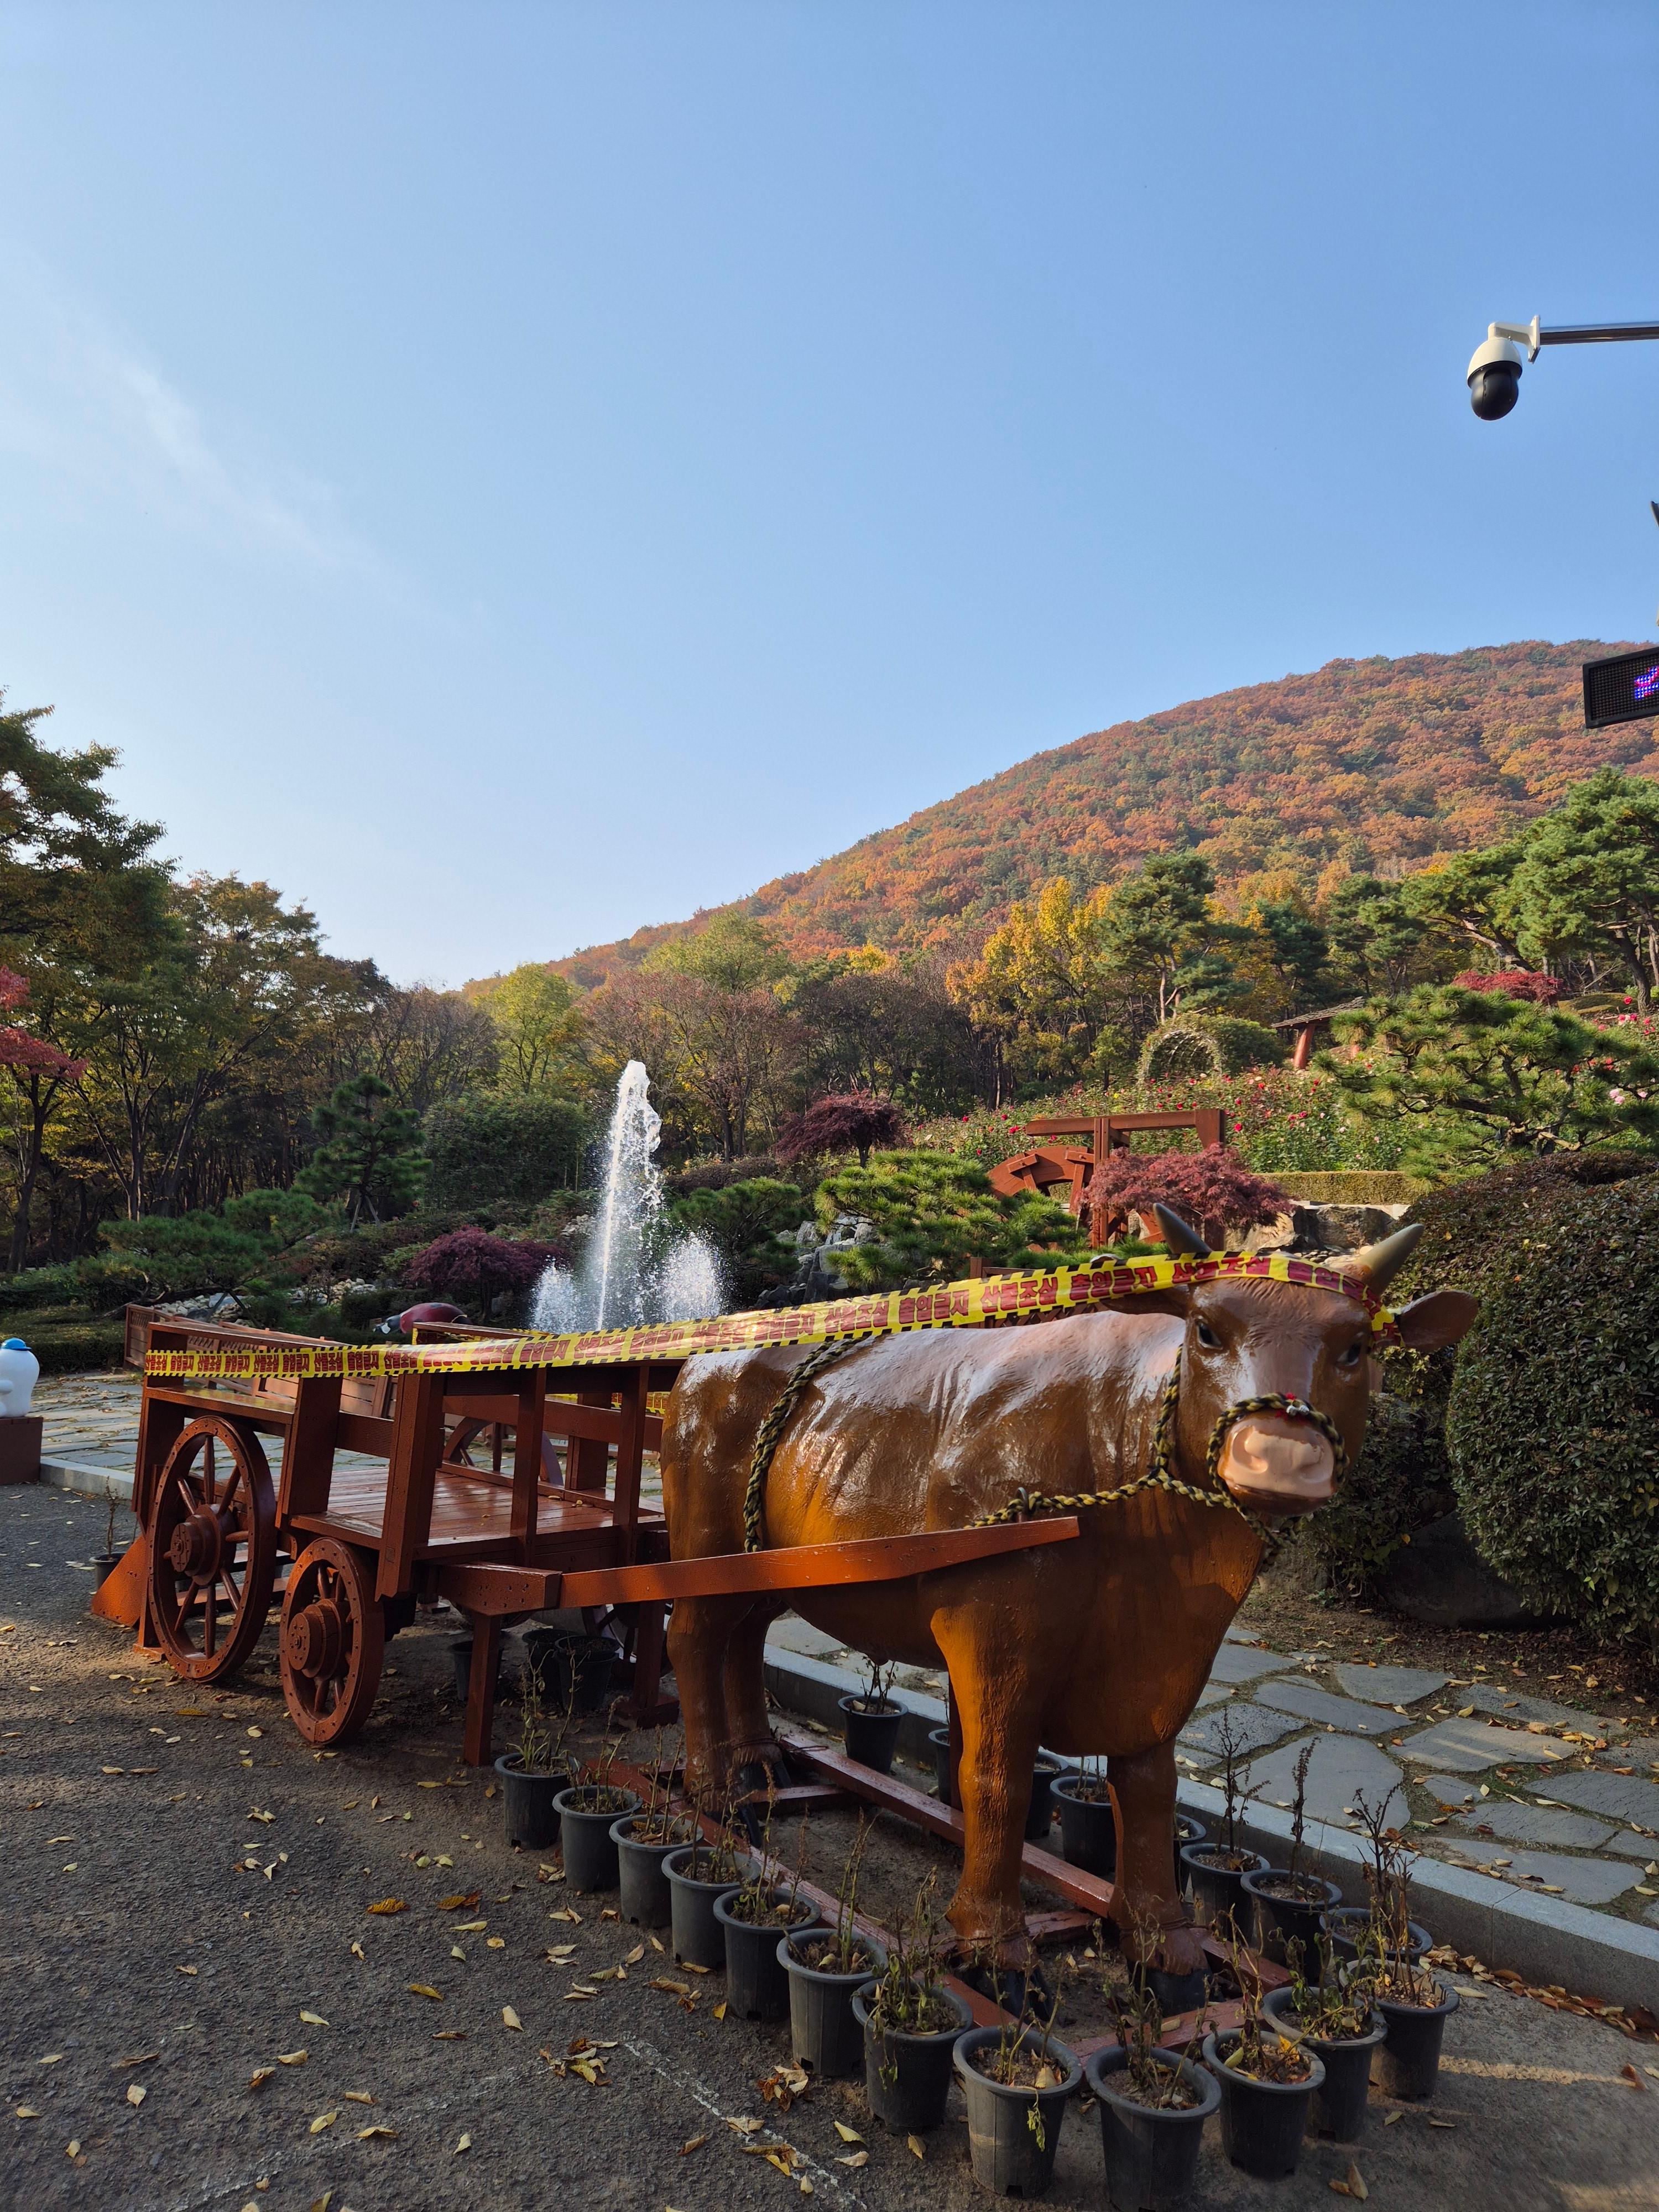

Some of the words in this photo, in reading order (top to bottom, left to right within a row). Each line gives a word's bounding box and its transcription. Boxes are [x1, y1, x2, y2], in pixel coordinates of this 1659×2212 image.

[198, 1355, 221, 1372] 산불조심
[253, 1354, 279, 1372] 산불조심
[283, 1354, 310, 1372] 출입금지
[314, 1352, 343, 1371] 산불조심
[347, 1350, 379, 1370] 출입금지
[519, 1340, 571, 1363] 출입금지
[574, 1335, 626, 1359] 산불조심
[629, 1328, 685, 1354] 출입금지
[824, 1300, 889, 1333] 산불조심
[899, 1290, 969, 1324] 출입금지
[980, 1277, 1057, 1313] 산불조심
[1070, 1266, 1158, 1301] 출입금지
